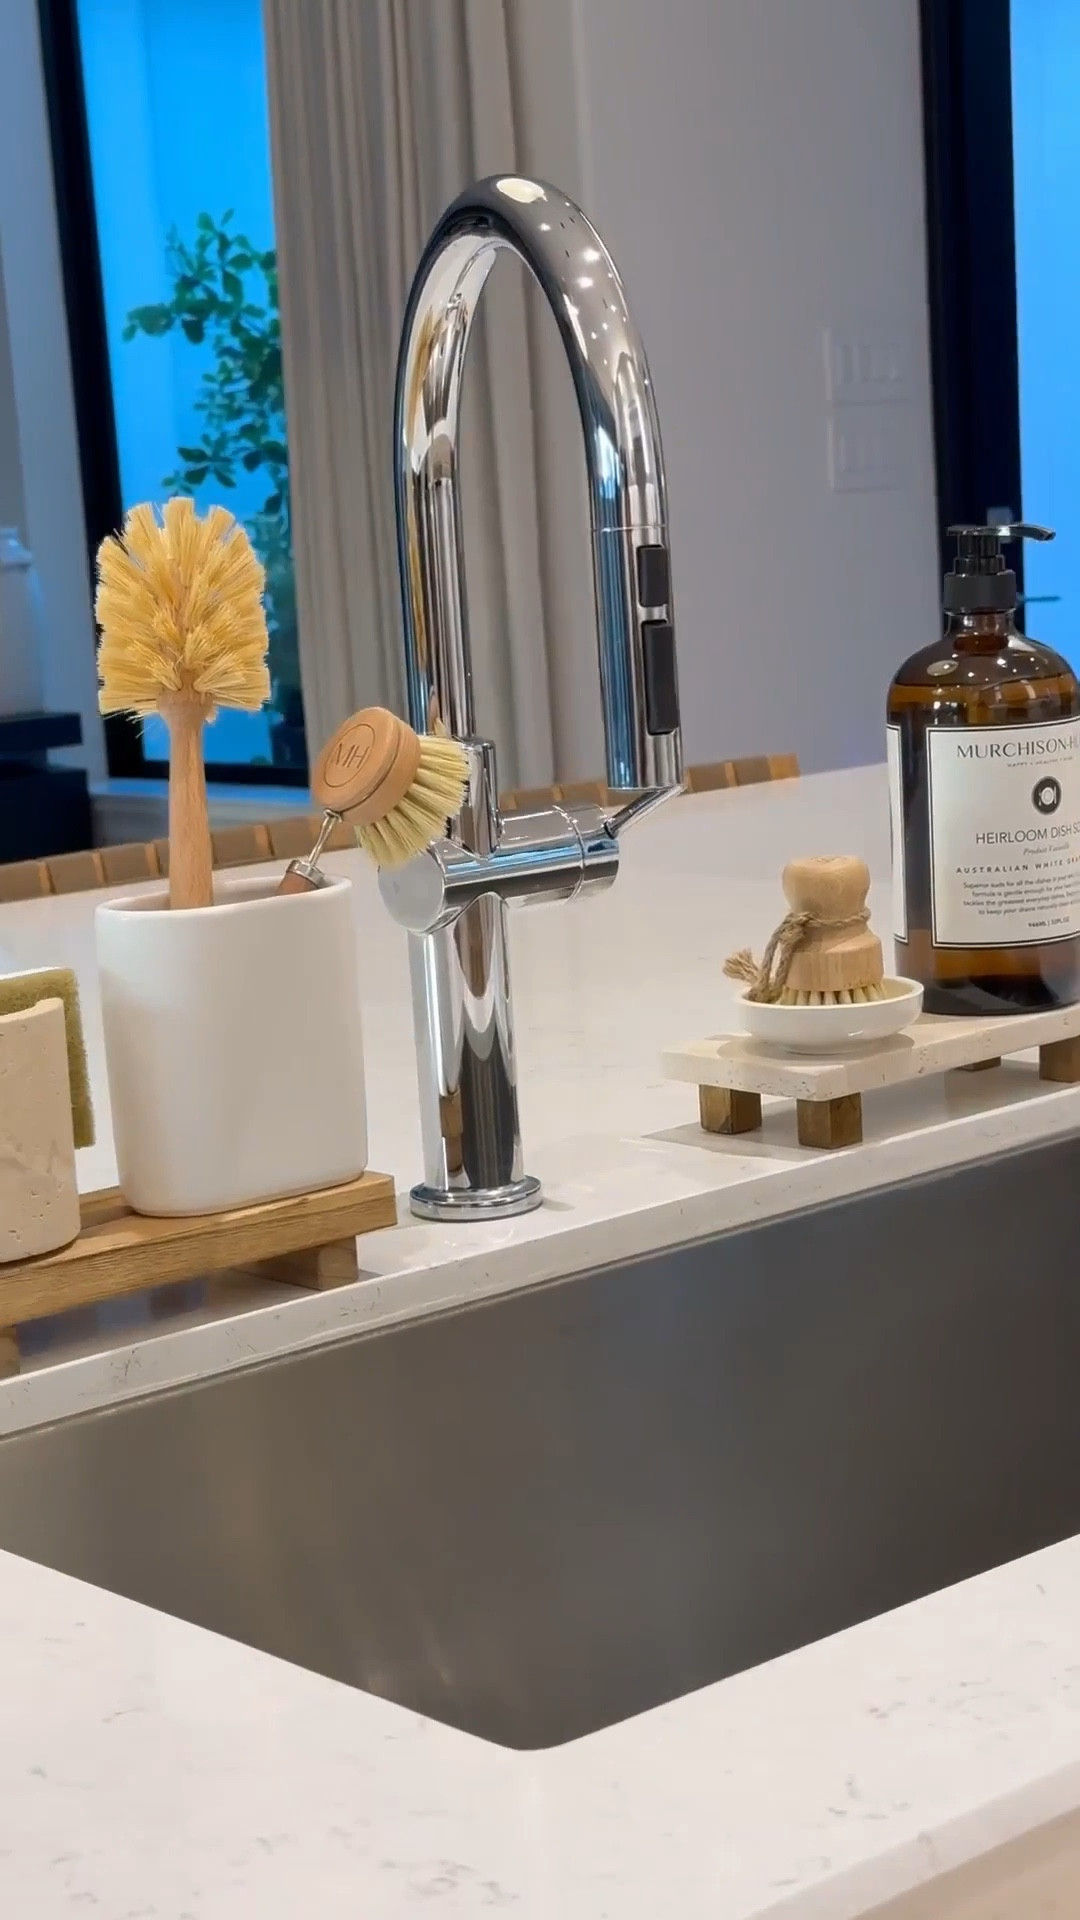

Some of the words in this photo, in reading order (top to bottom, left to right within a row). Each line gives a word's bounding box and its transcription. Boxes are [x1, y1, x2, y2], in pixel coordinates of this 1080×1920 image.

[333, 742, 370, 768] MH
[976, 828, 1047, 844] HEIRLOOM
[1050, 824, 1072, 839] DISH
[956, 864, 1029, 873] AUSTRALIAN
[1035, 860, 1063, 869] WHITE
